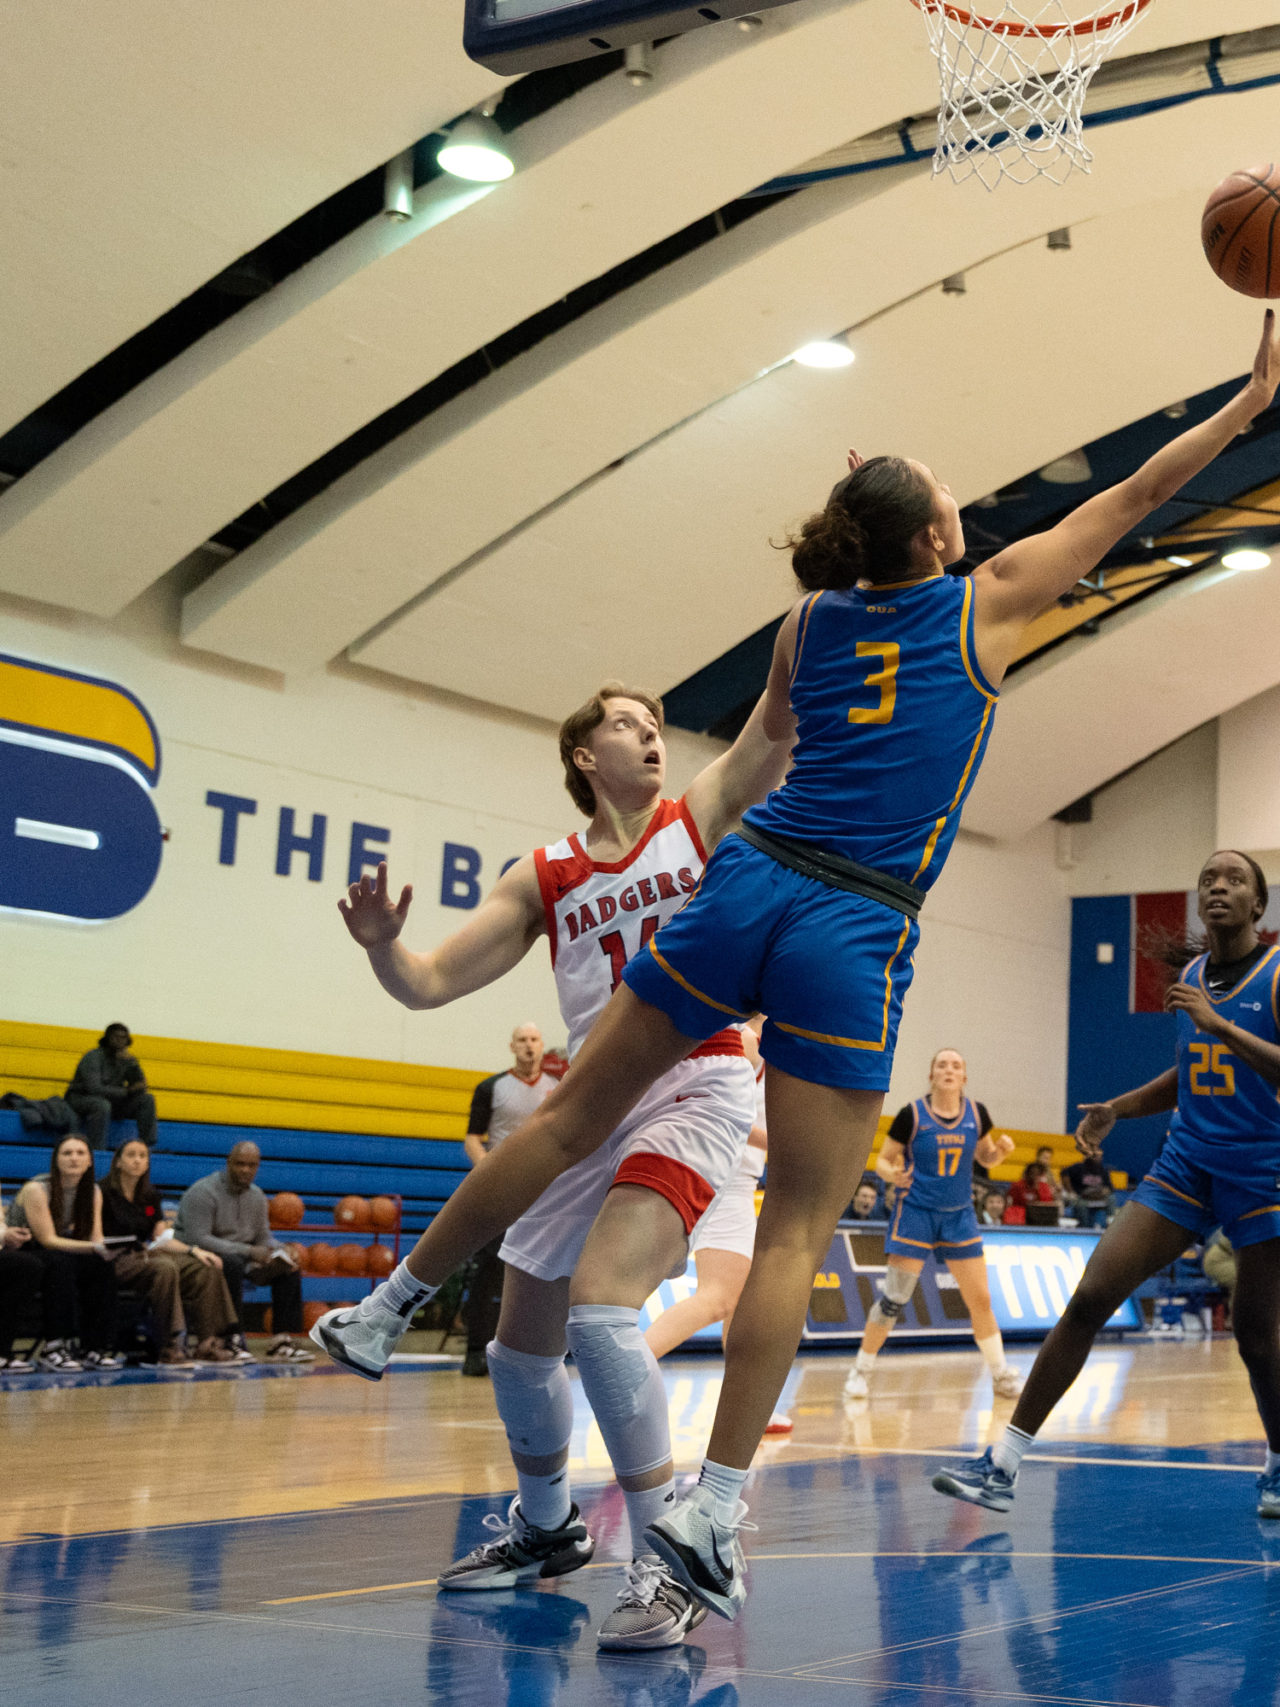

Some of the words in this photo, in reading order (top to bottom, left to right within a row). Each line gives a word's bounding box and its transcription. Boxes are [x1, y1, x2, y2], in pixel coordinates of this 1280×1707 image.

[847, 641, 900, 724] 3
[205, 789, 393, 897] THE
[564, 867, 697, 942] BADGERS
[1188, 1042, 1236, 1096] 25
[937, 1147, 963, 1177] 17
